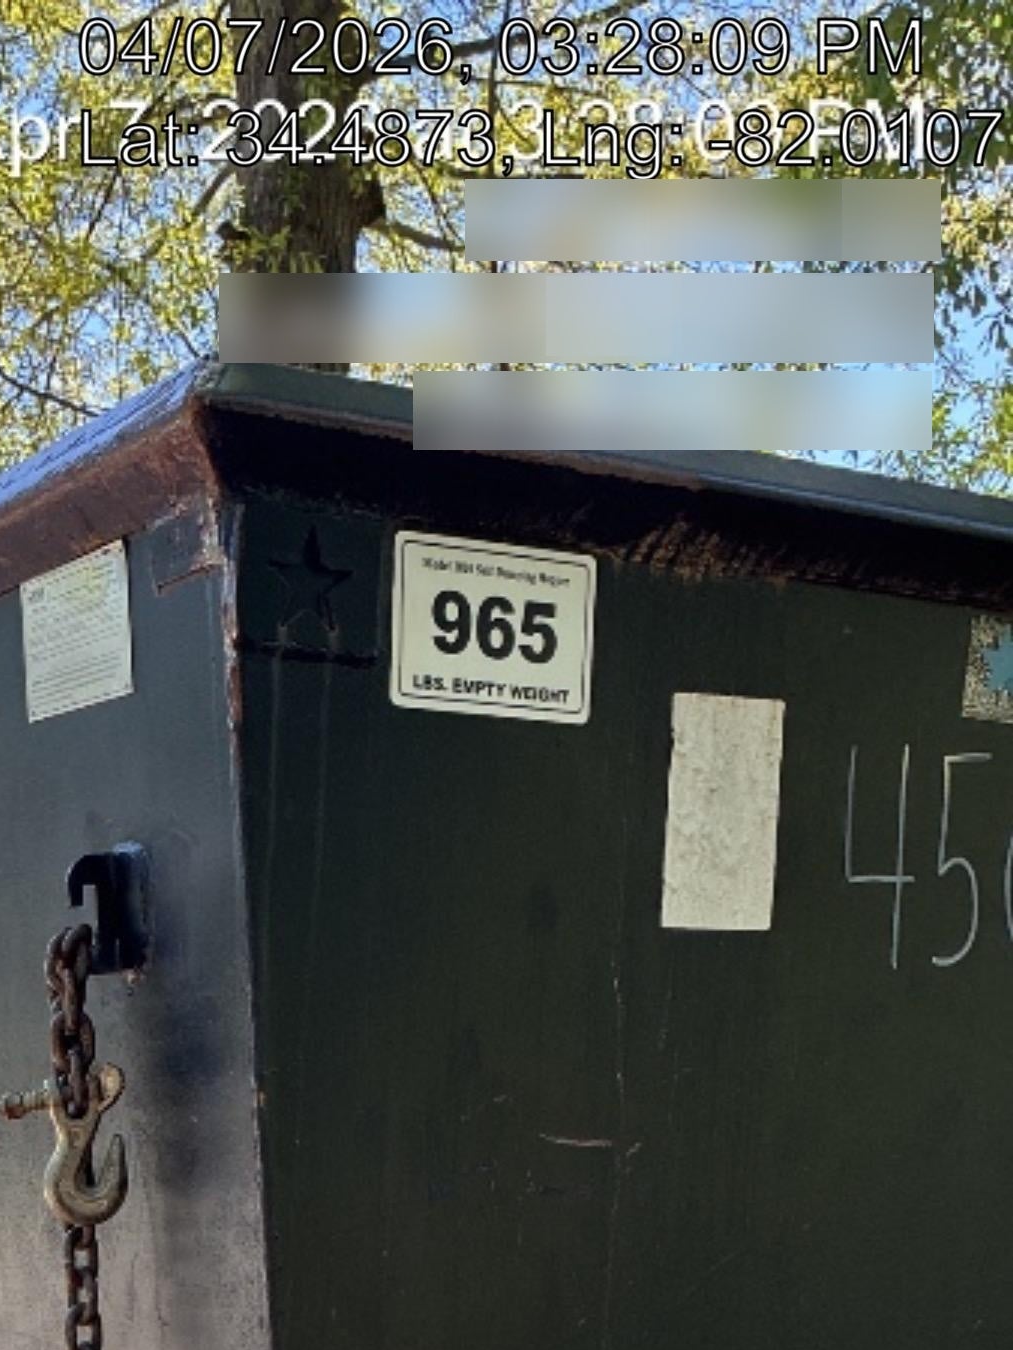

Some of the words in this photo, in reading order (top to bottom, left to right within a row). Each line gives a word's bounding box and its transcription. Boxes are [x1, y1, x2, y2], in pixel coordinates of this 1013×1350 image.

[431, 590, 558, 664] 965
[412, 673, 447, 691] LBS.
[451, 677, 507, 697] EMPTY
[509, 683, 571, 704] WEIGHT
[844, 743, 1013, 970] 45
